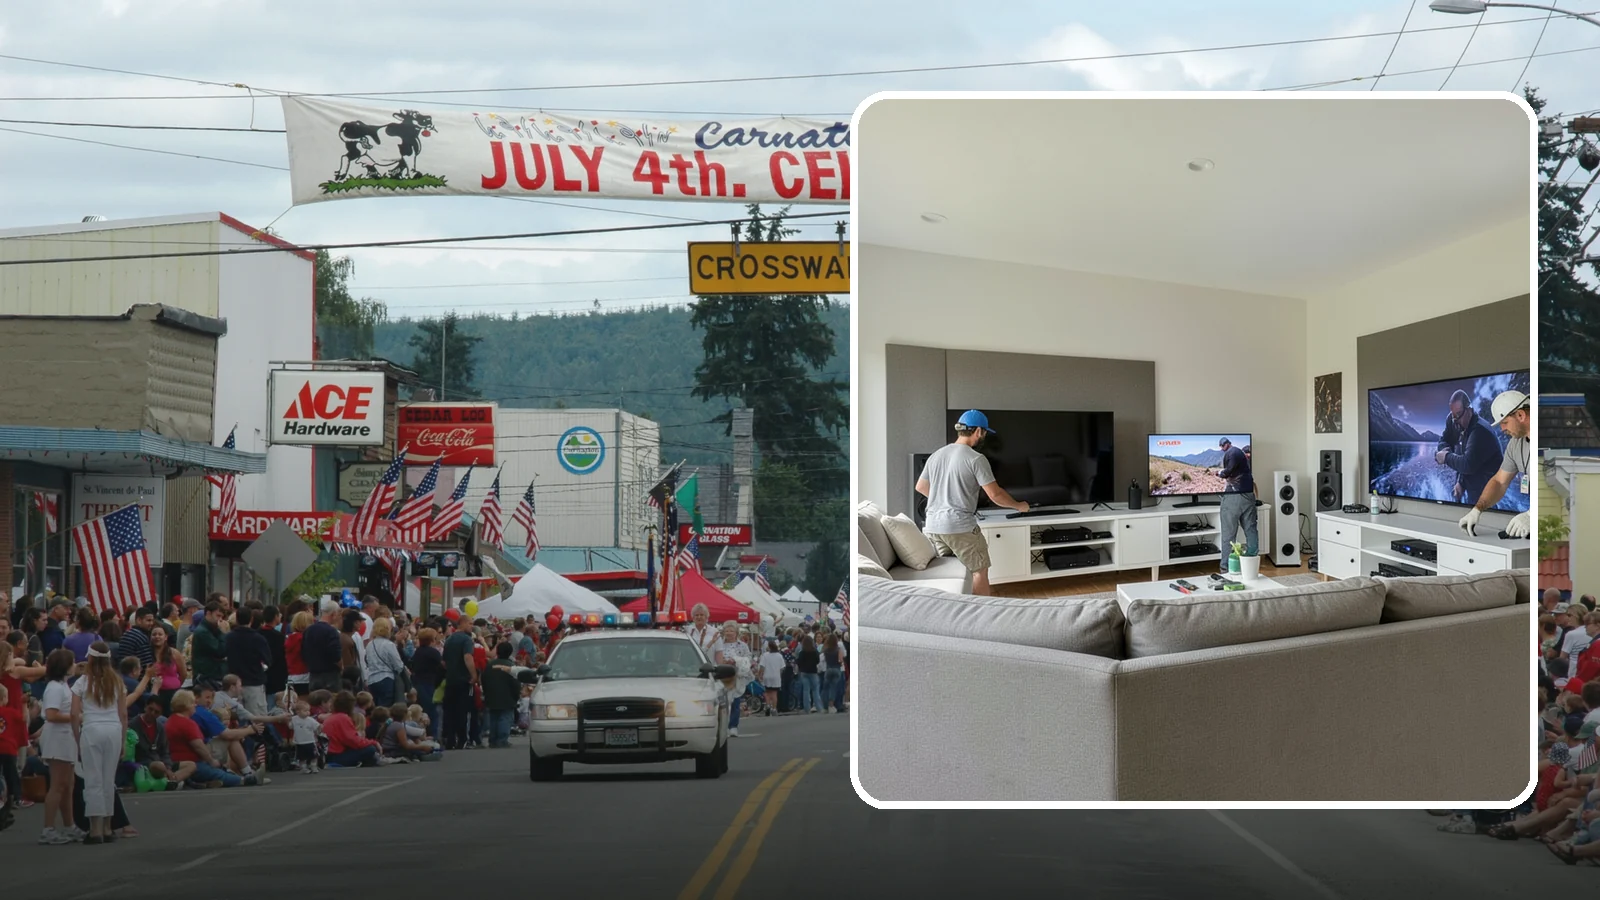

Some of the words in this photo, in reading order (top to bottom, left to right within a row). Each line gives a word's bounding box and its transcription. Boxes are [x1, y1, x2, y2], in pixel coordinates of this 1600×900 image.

[481, 142, 605, 193] JULY
[632, 150, 746, 197] 4th.
[697, 254, 850, 280] CROSSWA
[283, 380, 374, 420] ACE
[406, 409, 452, 422] CEDAR
[283, 421, 371, 436] Hardware
[416, 428, 477, 447] Coca-Cola
[353, 467, 384, 480] Simpl
[83, 484, 94, 494] St.
[96, 485, 124, 495] Vincent
[126, 485, 135, 494] de
[138, 486, 155, 495] Paul
[81, 503, 153, 522] THT
[688, 526, 741, 535] CRNATION
[699, 535, 730, 543] GLASS
